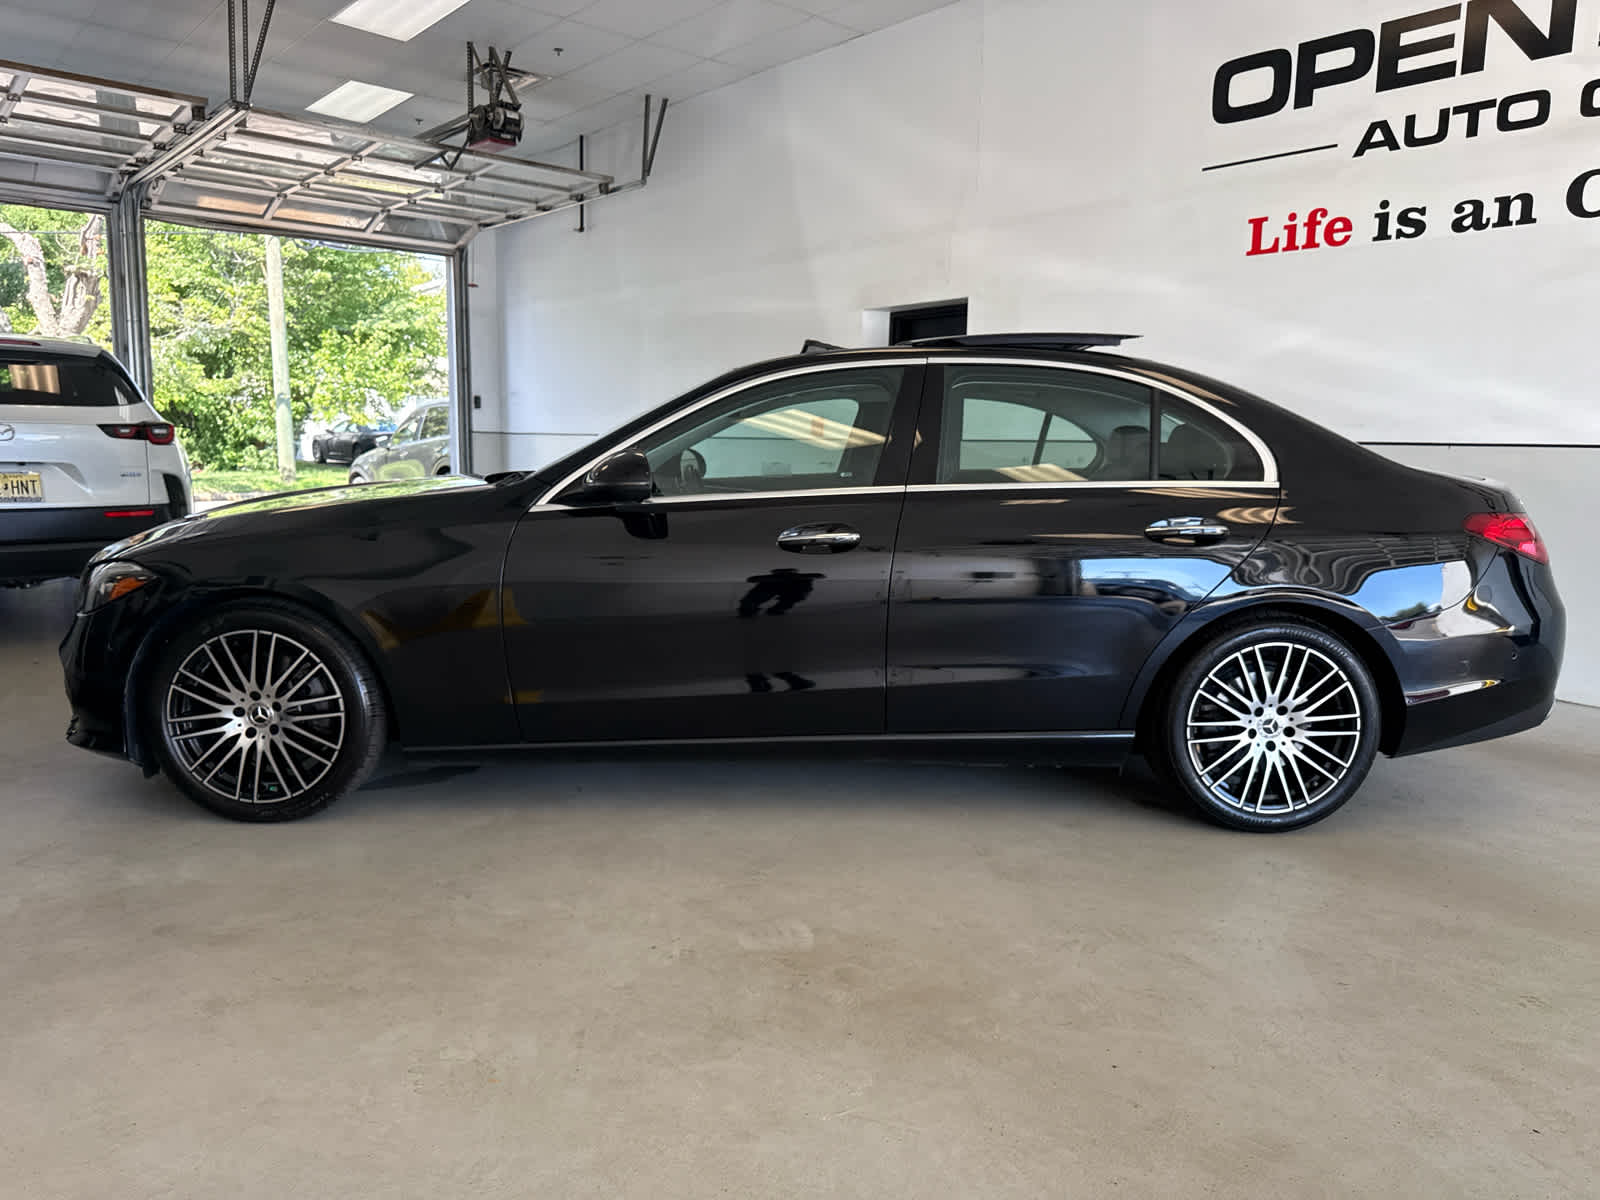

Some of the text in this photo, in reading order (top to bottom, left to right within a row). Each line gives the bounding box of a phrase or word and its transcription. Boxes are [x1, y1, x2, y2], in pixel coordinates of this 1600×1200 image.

[1212, 0, 1578, 125] OPEN
[1352, 89, 1551, 158] AUTO
[1245, 207, 1353, 257] Life
[1372, 199, 1427, 242] is
[1451, 192, 1537, 234] an
